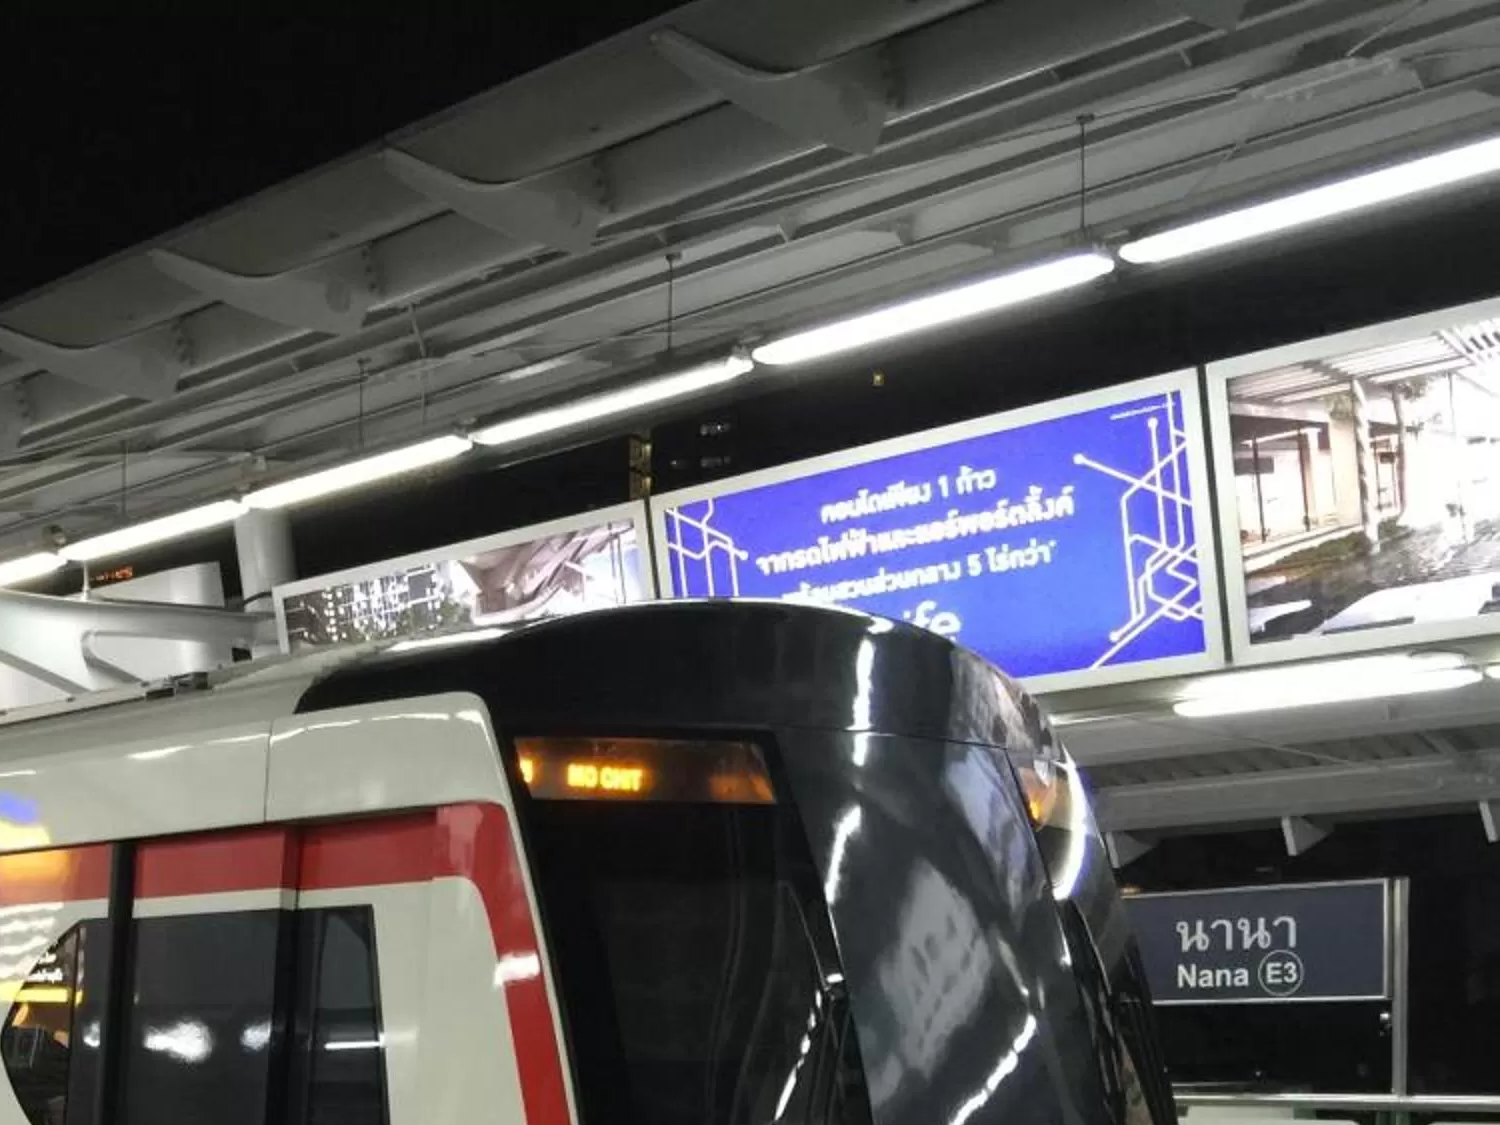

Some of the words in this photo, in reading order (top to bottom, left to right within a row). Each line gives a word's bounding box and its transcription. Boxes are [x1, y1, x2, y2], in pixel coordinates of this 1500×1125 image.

[938, 475, 949, 499] 1
[956, 465, 996, 495] ก้าว
[967, 553, 982, 577] 5
[1176, 915, 1297, 951] นานา
[1177, 963, 1250, 989] Nana
[1265, 960, 1298, 985] E3
